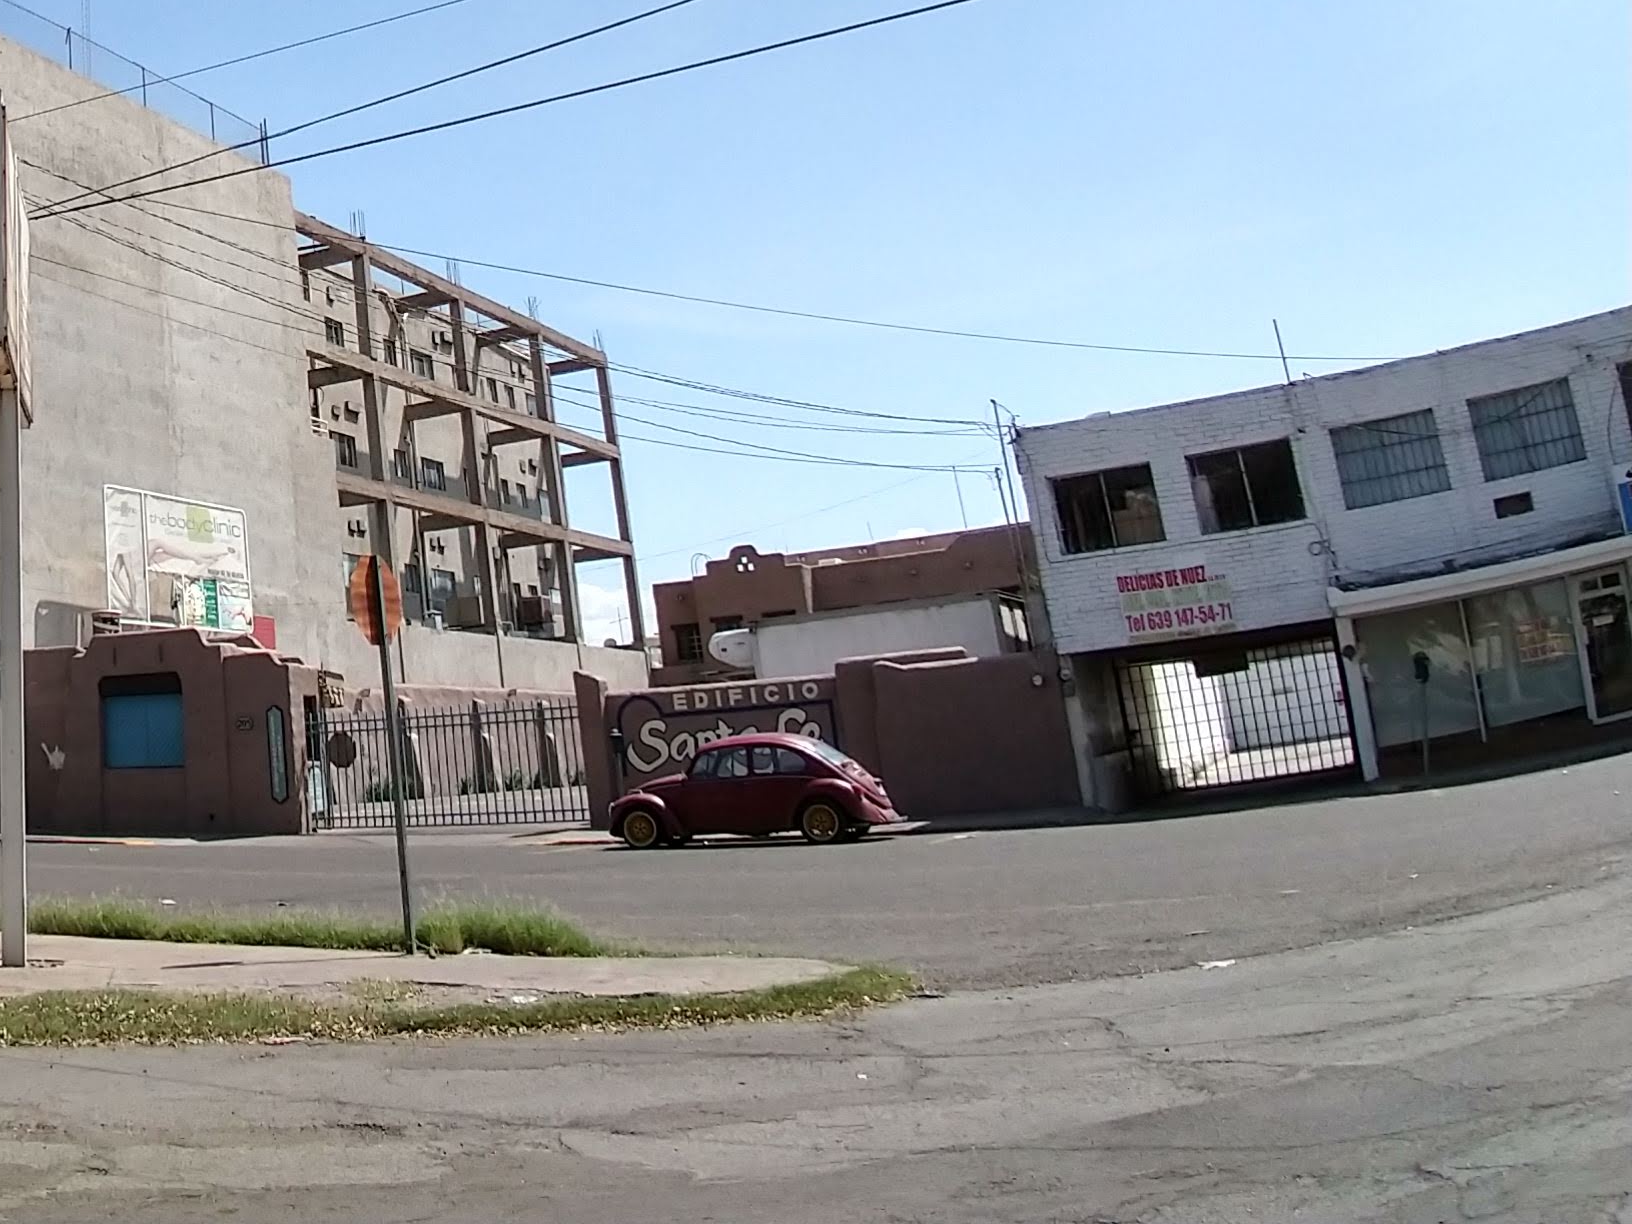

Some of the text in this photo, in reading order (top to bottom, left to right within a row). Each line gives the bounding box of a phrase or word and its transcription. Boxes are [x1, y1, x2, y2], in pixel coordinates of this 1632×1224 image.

[1116, 571, 1164, 593] DELICIAS
[1164, 569, 1180, 588] DE
[1179, 565, 1207, 584] NUEZ
[1125, 614, 1146, 633] Tel
[1147, 610, 1173, 631] 639
[1175, 602, 1233, 628] 147-54-71
[672, 682, 818, 711] EDIFICIO
